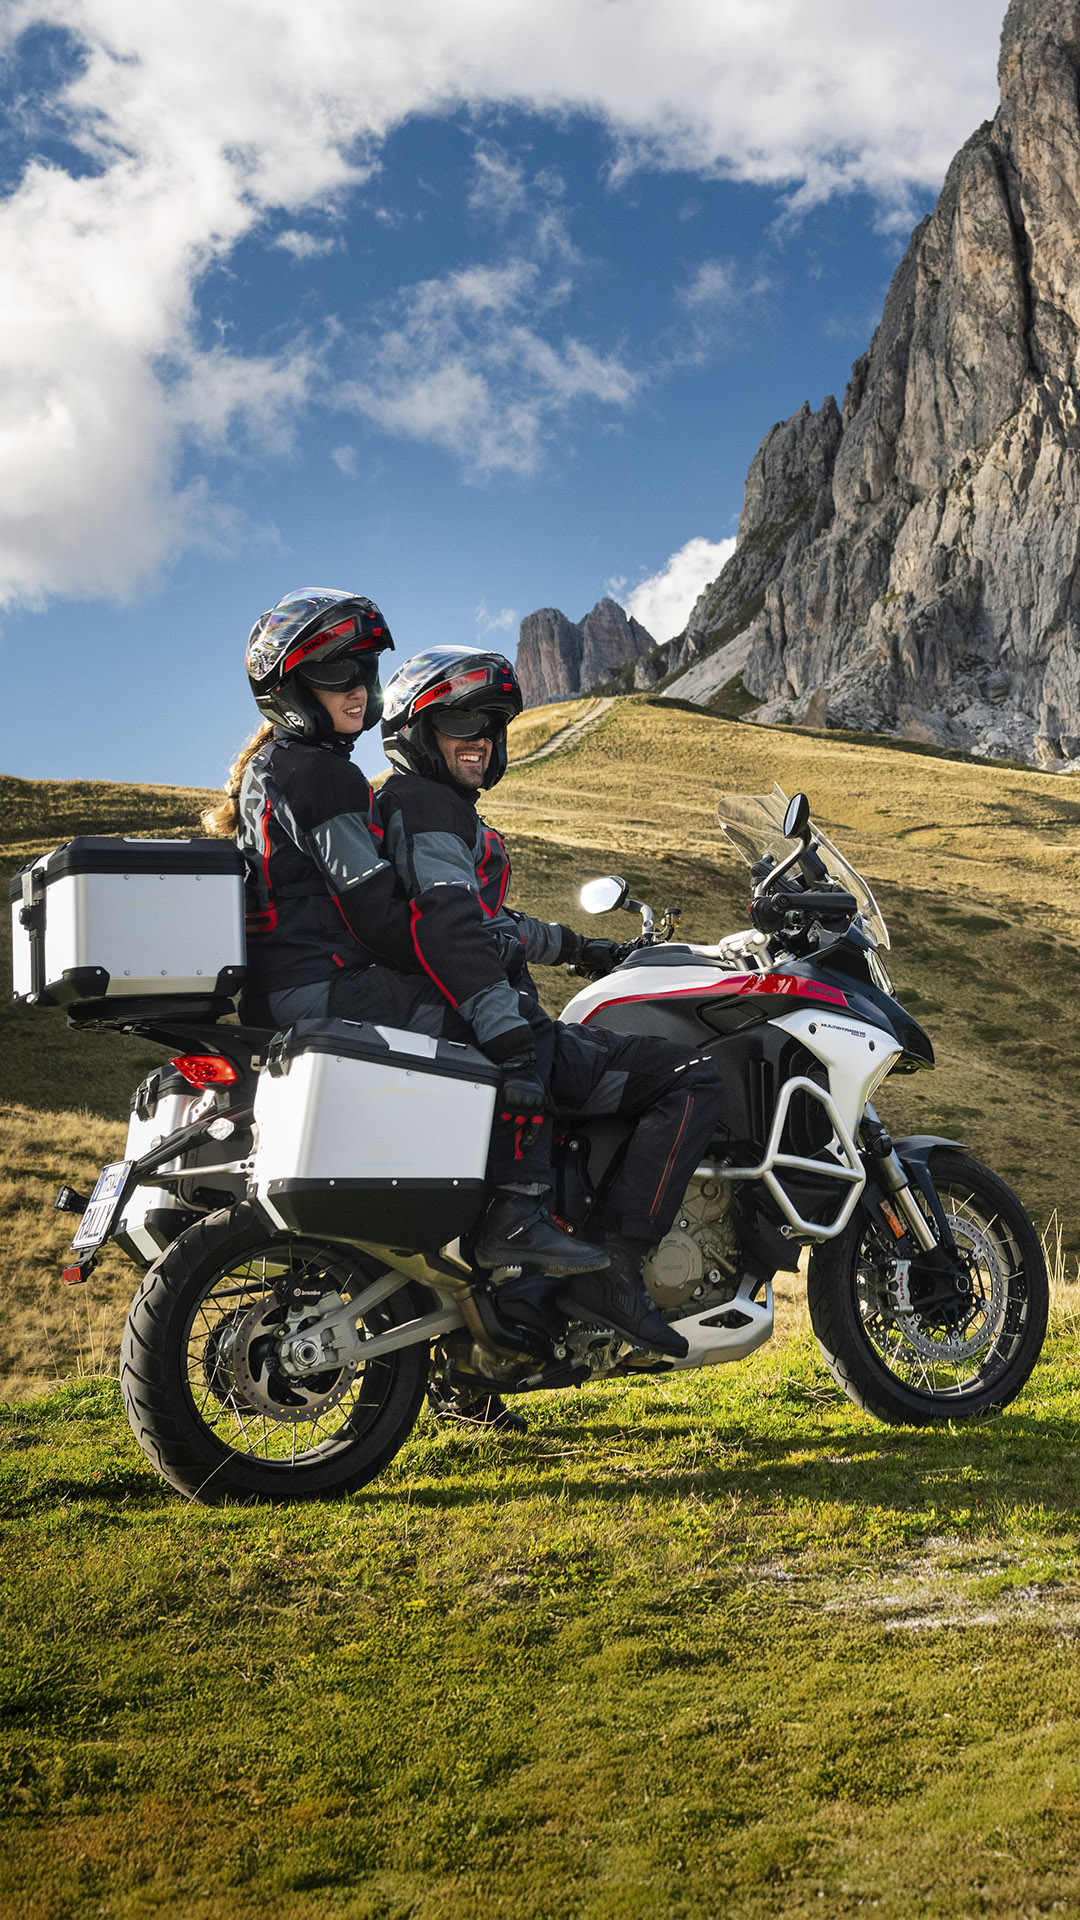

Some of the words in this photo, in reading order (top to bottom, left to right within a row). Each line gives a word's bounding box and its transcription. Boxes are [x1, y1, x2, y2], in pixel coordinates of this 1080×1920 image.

[302, 629, 337, 655] DUCATI
[433, 676, 469, 697] DUCATI
[807, 984, 841, 1000] DUCATI
[76, 1203, 115, 1240] RALLY
